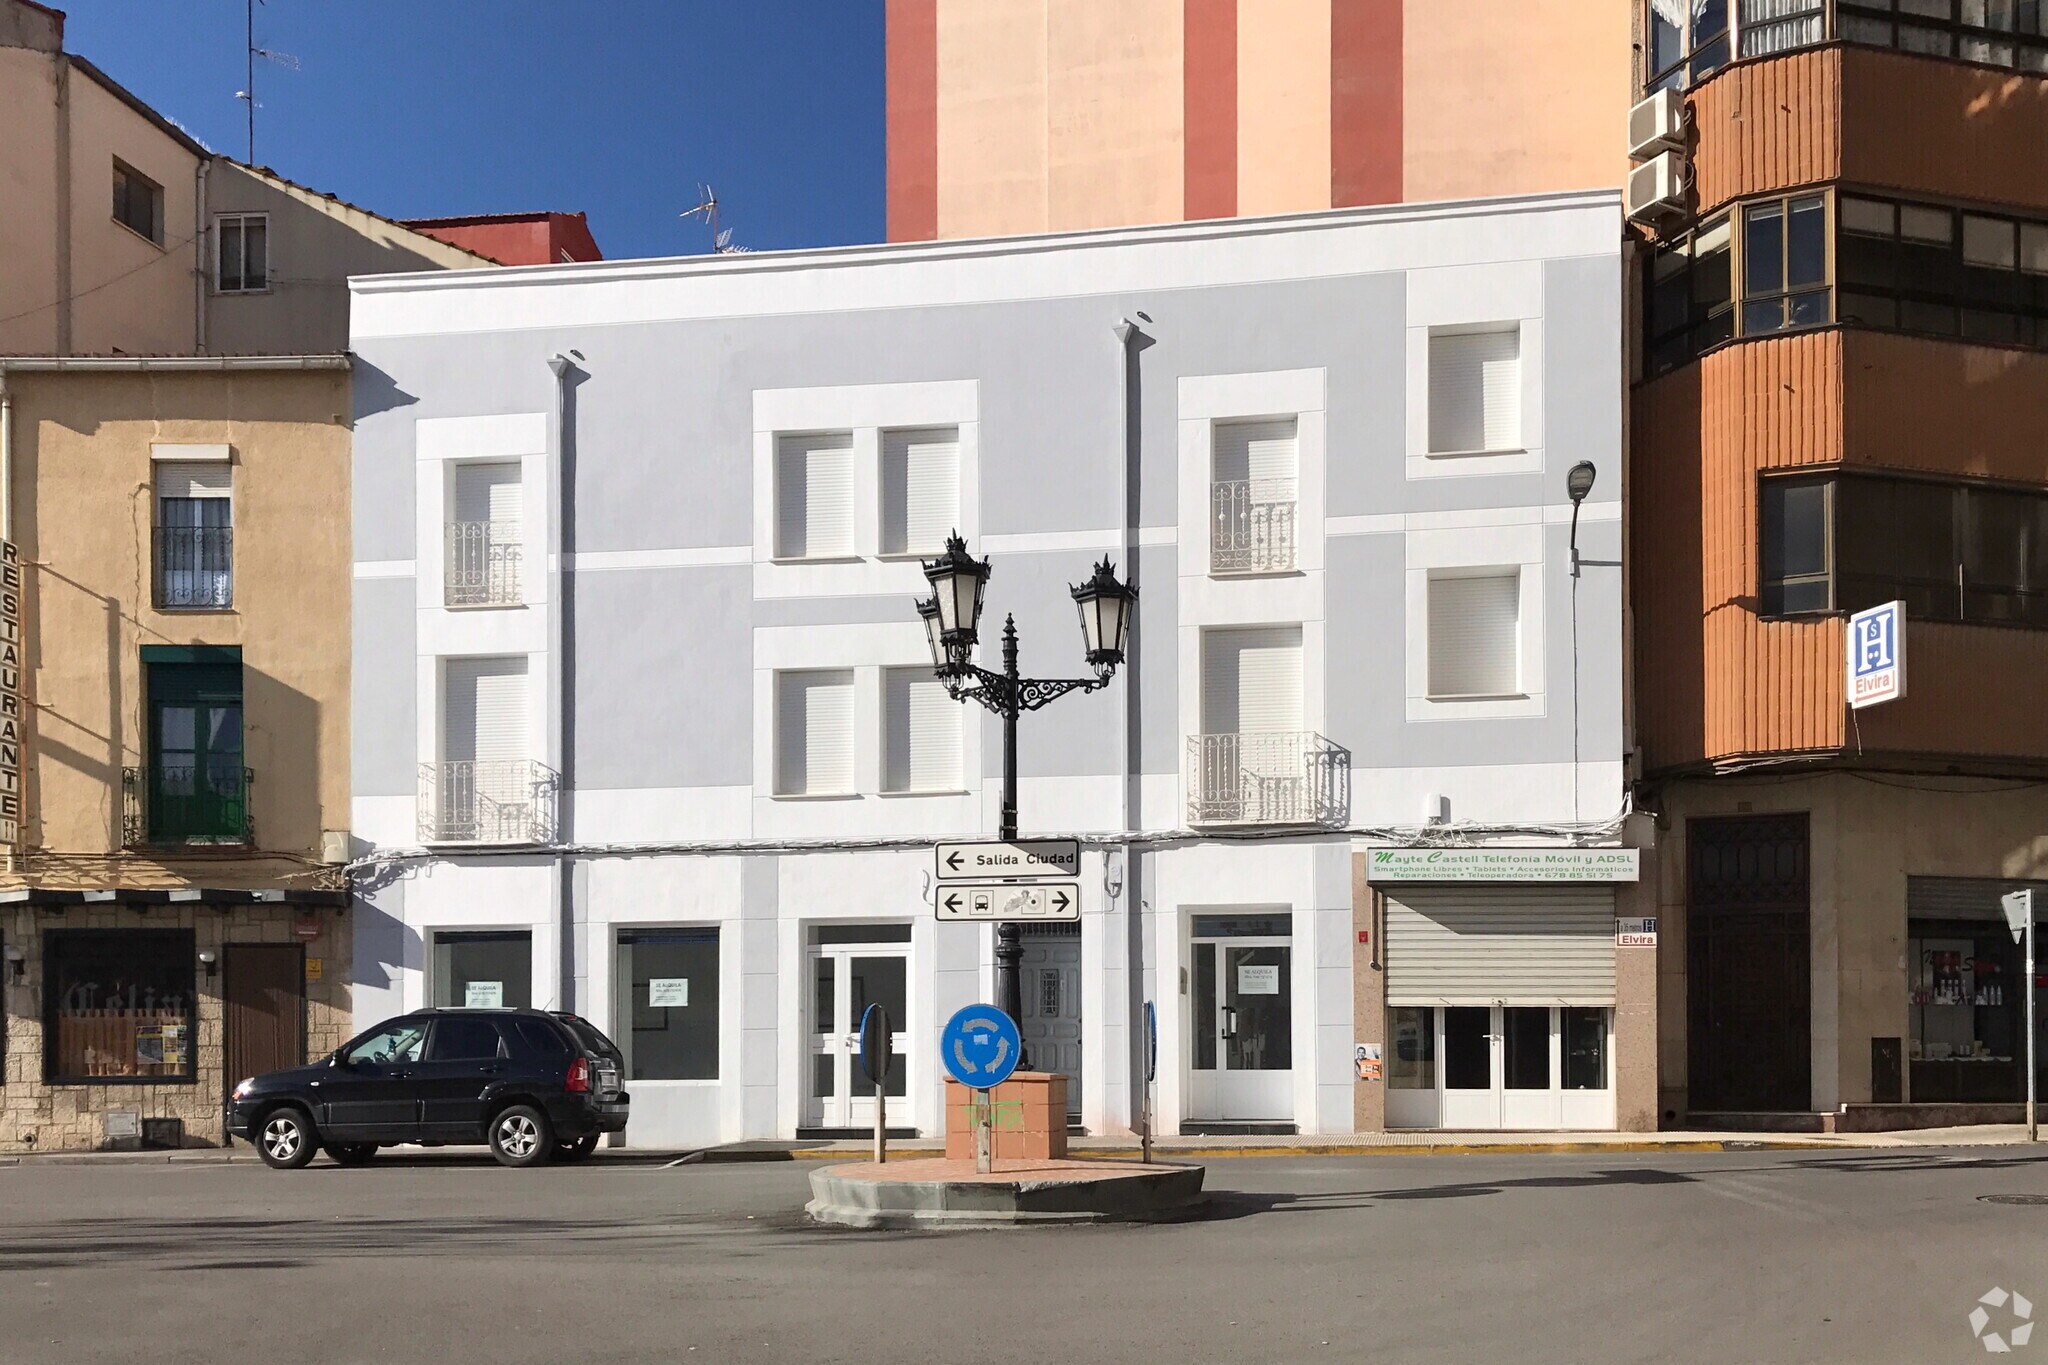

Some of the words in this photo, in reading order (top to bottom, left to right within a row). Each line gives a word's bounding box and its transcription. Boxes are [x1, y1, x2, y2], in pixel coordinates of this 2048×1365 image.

[0, 541, 18, 816] RESTAURANTE
[1855, 674, 1890, 694] Elvira
[976, 854, 1019, 866] Salida
[1026, 853, 1074, 865] Ciudad
[1374, 851, 1423, 864] Mayte
[1426, 851, 1479, 863] Castell
[1482, 855, 1541, 863] Telefonía
[1545, 855, 1581, 863] Móvil
[1585, 856, 1592, 864] y
[1596, 855, 1634, 863] ADSL
[1622, 935, 1654, 944] Elvira
